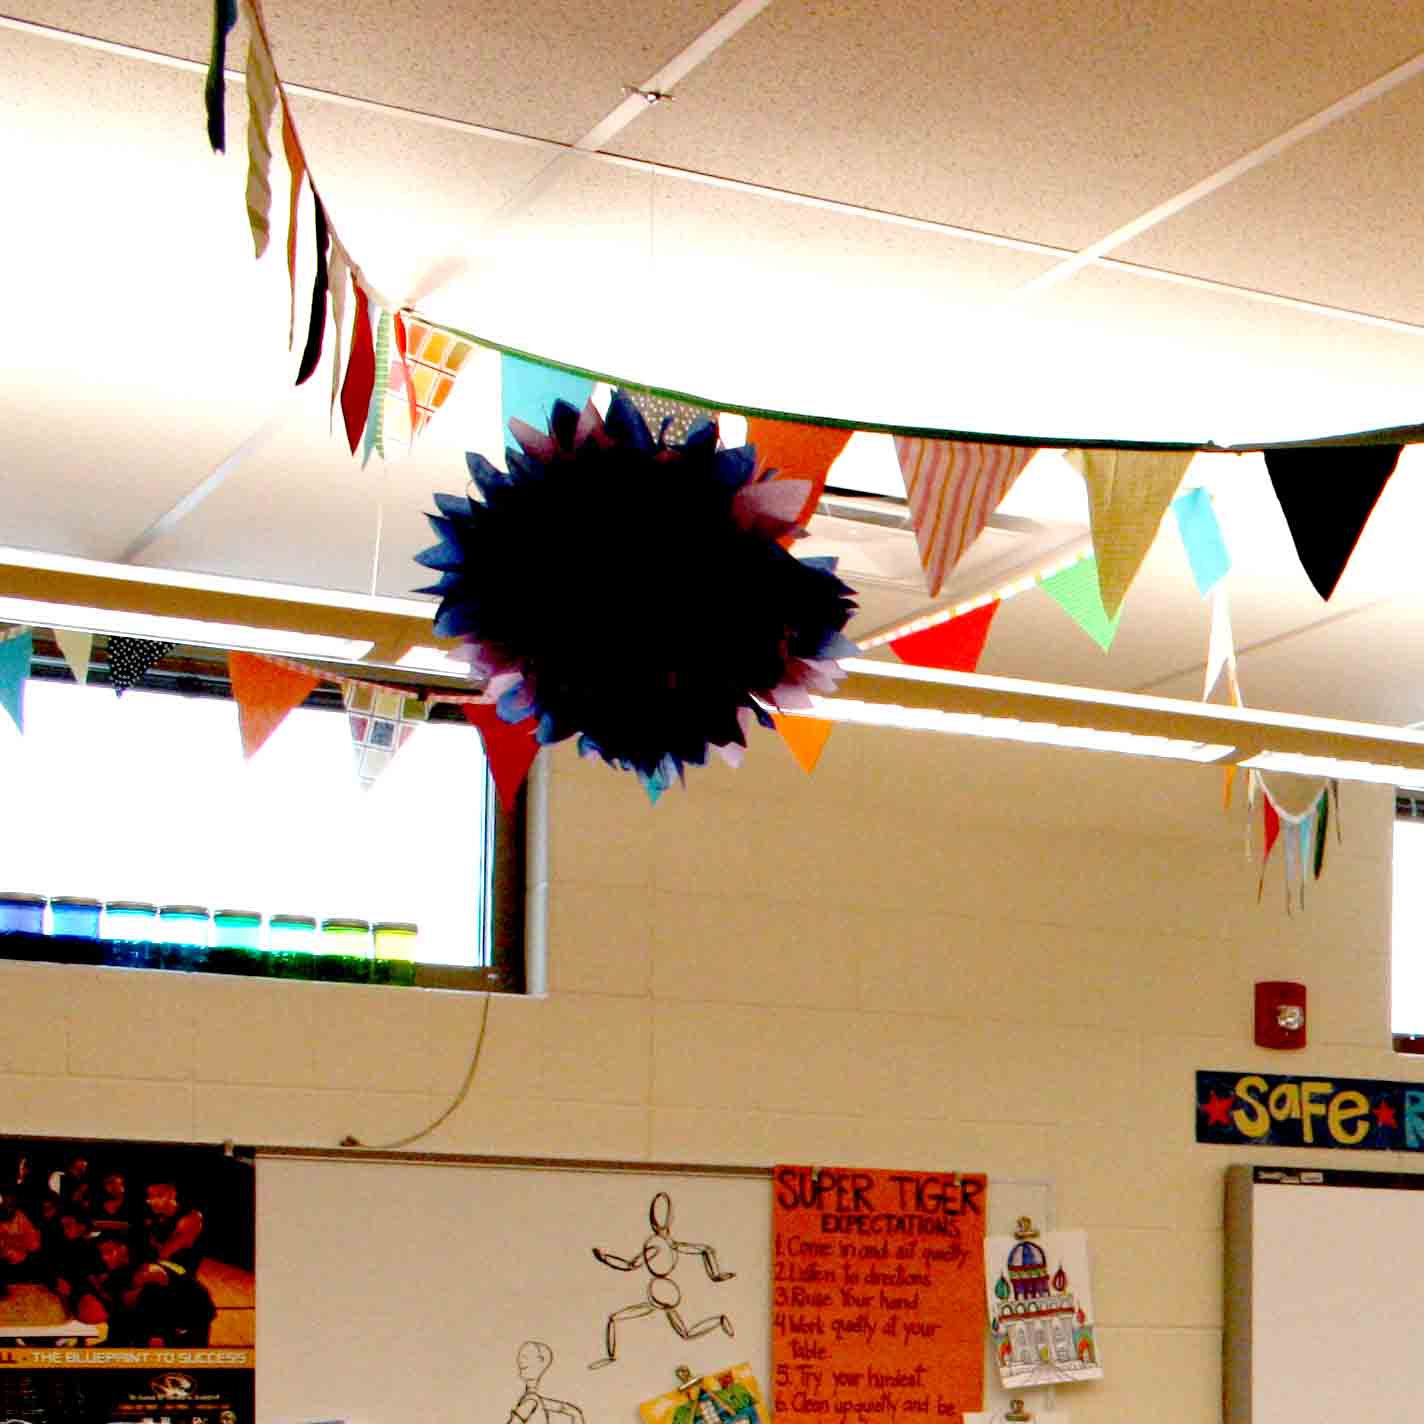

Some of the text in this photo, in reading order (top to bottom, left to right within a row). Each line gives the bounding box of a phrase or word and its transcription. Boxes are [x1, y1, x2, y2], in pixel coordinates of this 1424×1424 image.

[777, 1171, 985, 1218] SUPER TIGER
[820, 1214, 961, 1238] EXPECTATIONS
[32, 1351, 61, 1364] THE
[156, 1352, 177, 1364] TO
[179, 1352, 247, 1364] SUCCESS
